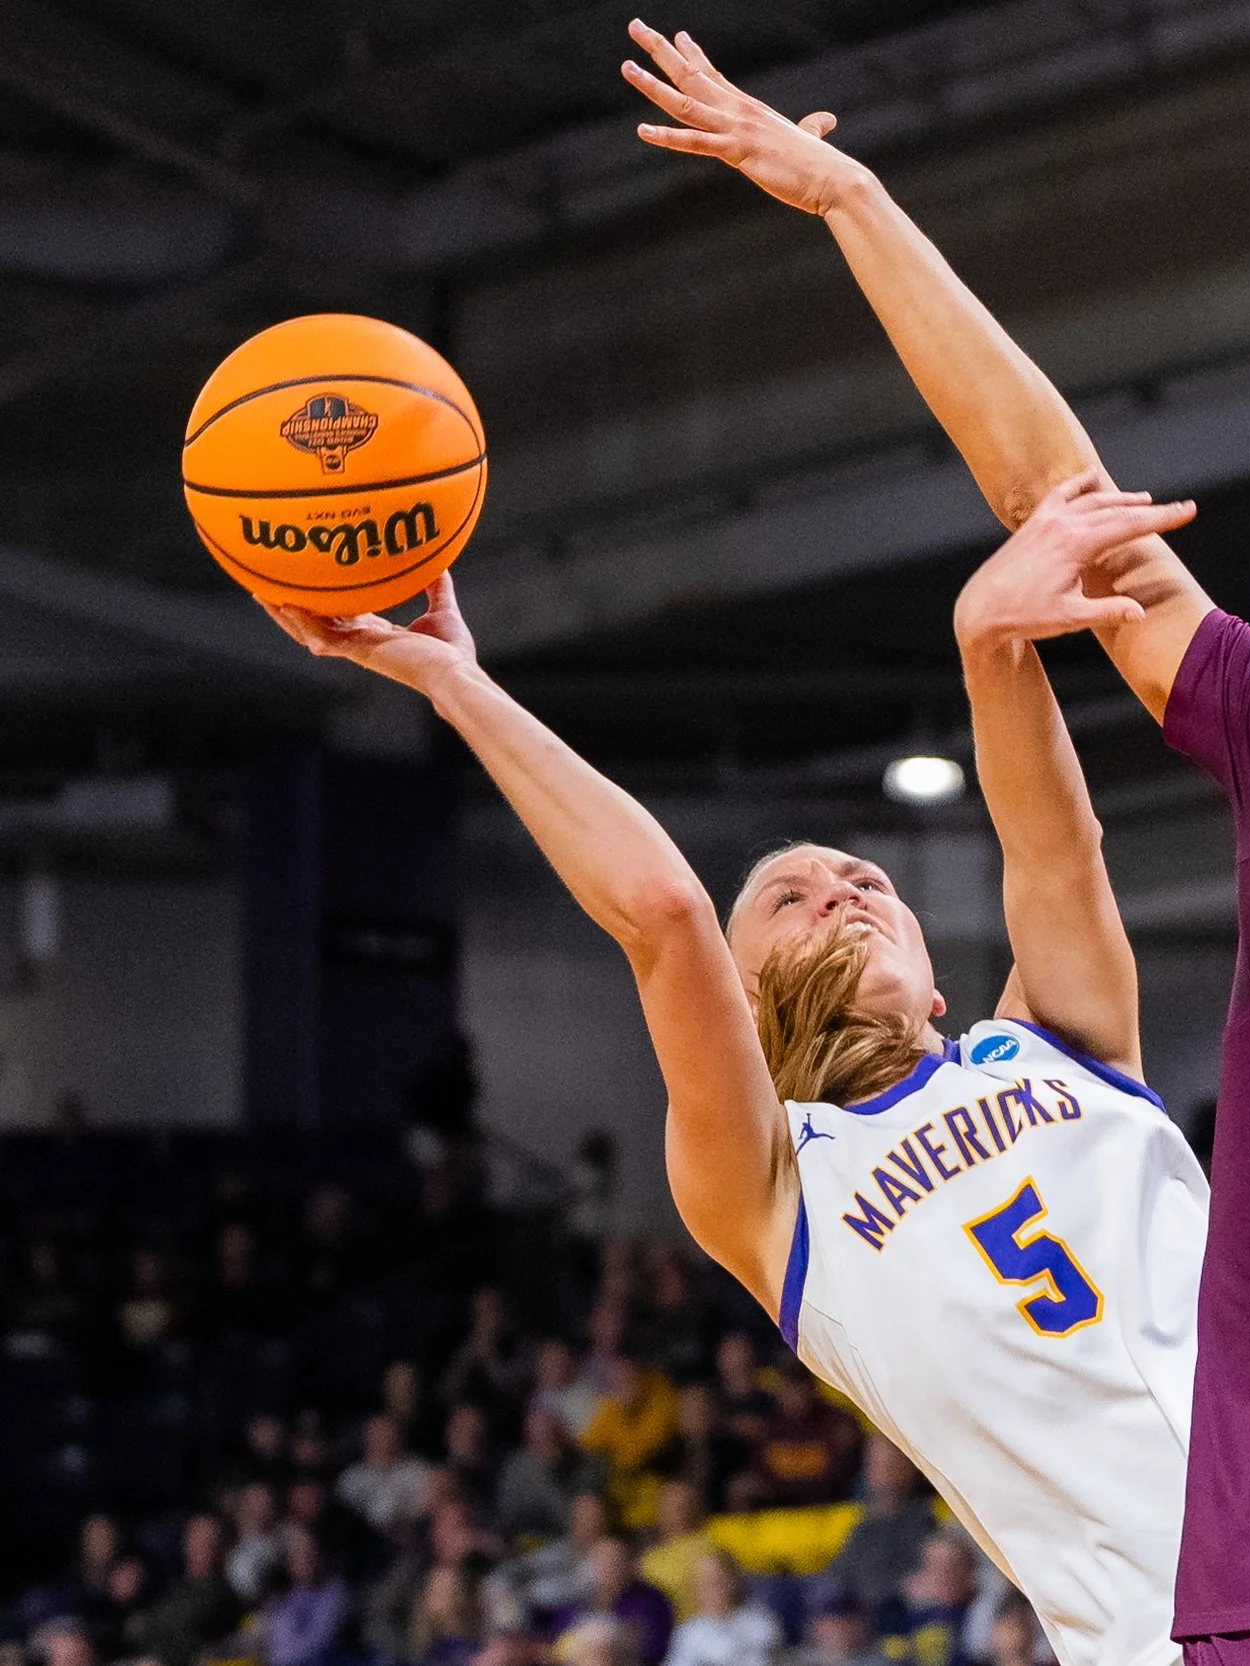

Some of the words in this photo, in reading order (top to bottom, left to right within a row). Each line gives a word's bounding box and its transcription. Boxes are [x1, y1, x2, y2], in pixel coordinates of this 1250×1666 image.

[281, 414, 377, 437] CHAMPIONSHIP
[238, 501, 441, 567] Wilson
[982, 1039, 1017, 1064] NCAA
[841, 1077, 1083, 1253] MAVERICKS
[961, 1175, 1105, 1338] 5
